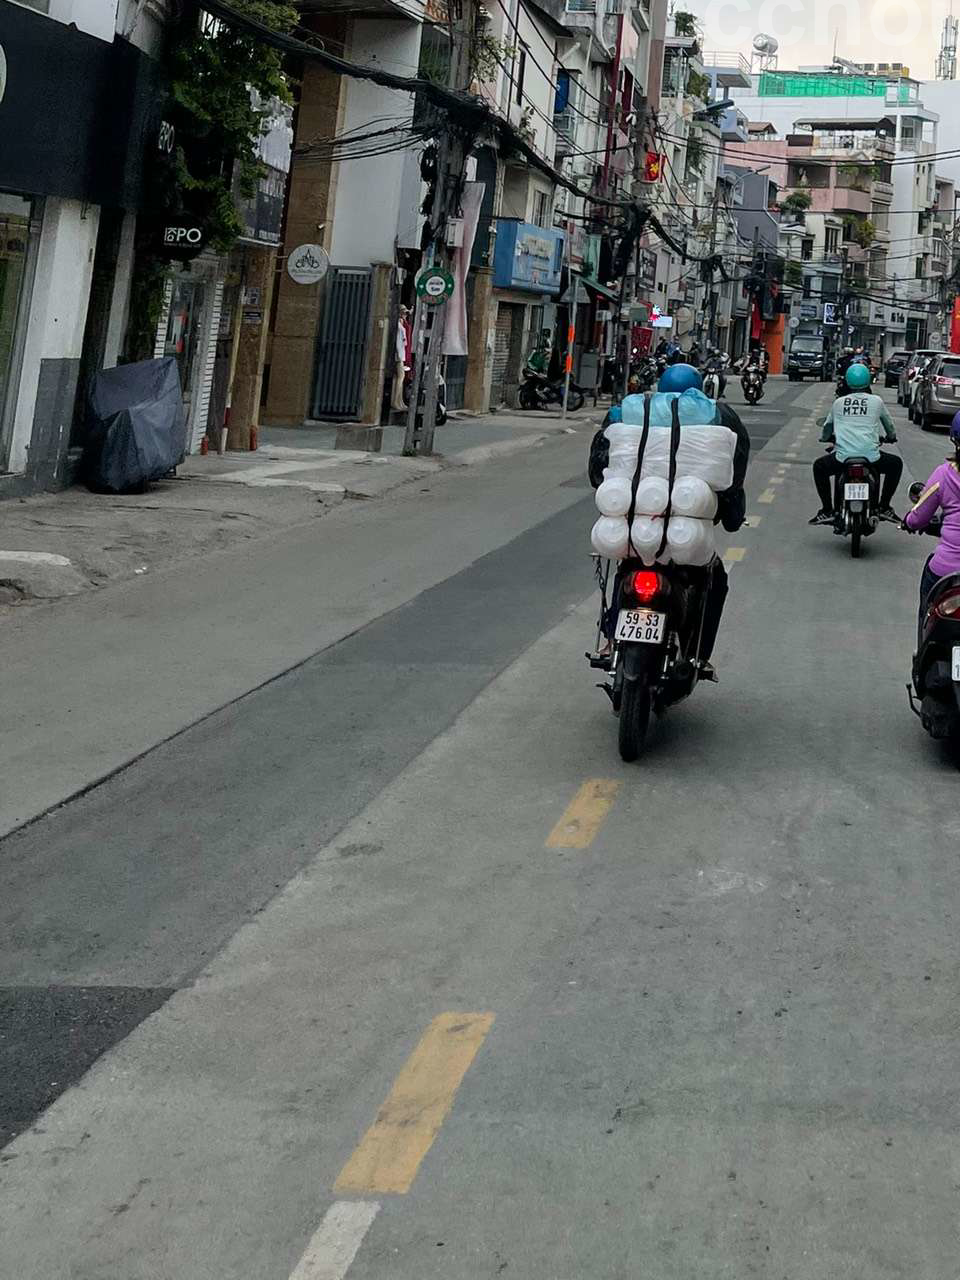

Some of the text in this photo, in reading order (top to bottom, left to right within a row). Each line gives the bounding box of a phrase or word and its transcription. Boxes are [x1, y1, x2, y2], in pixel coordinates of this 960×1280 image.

[843, 397, 868, 407] BAE
[843, 406, 868, 416] MIN
[619, 624, 660, 641] 476.04
